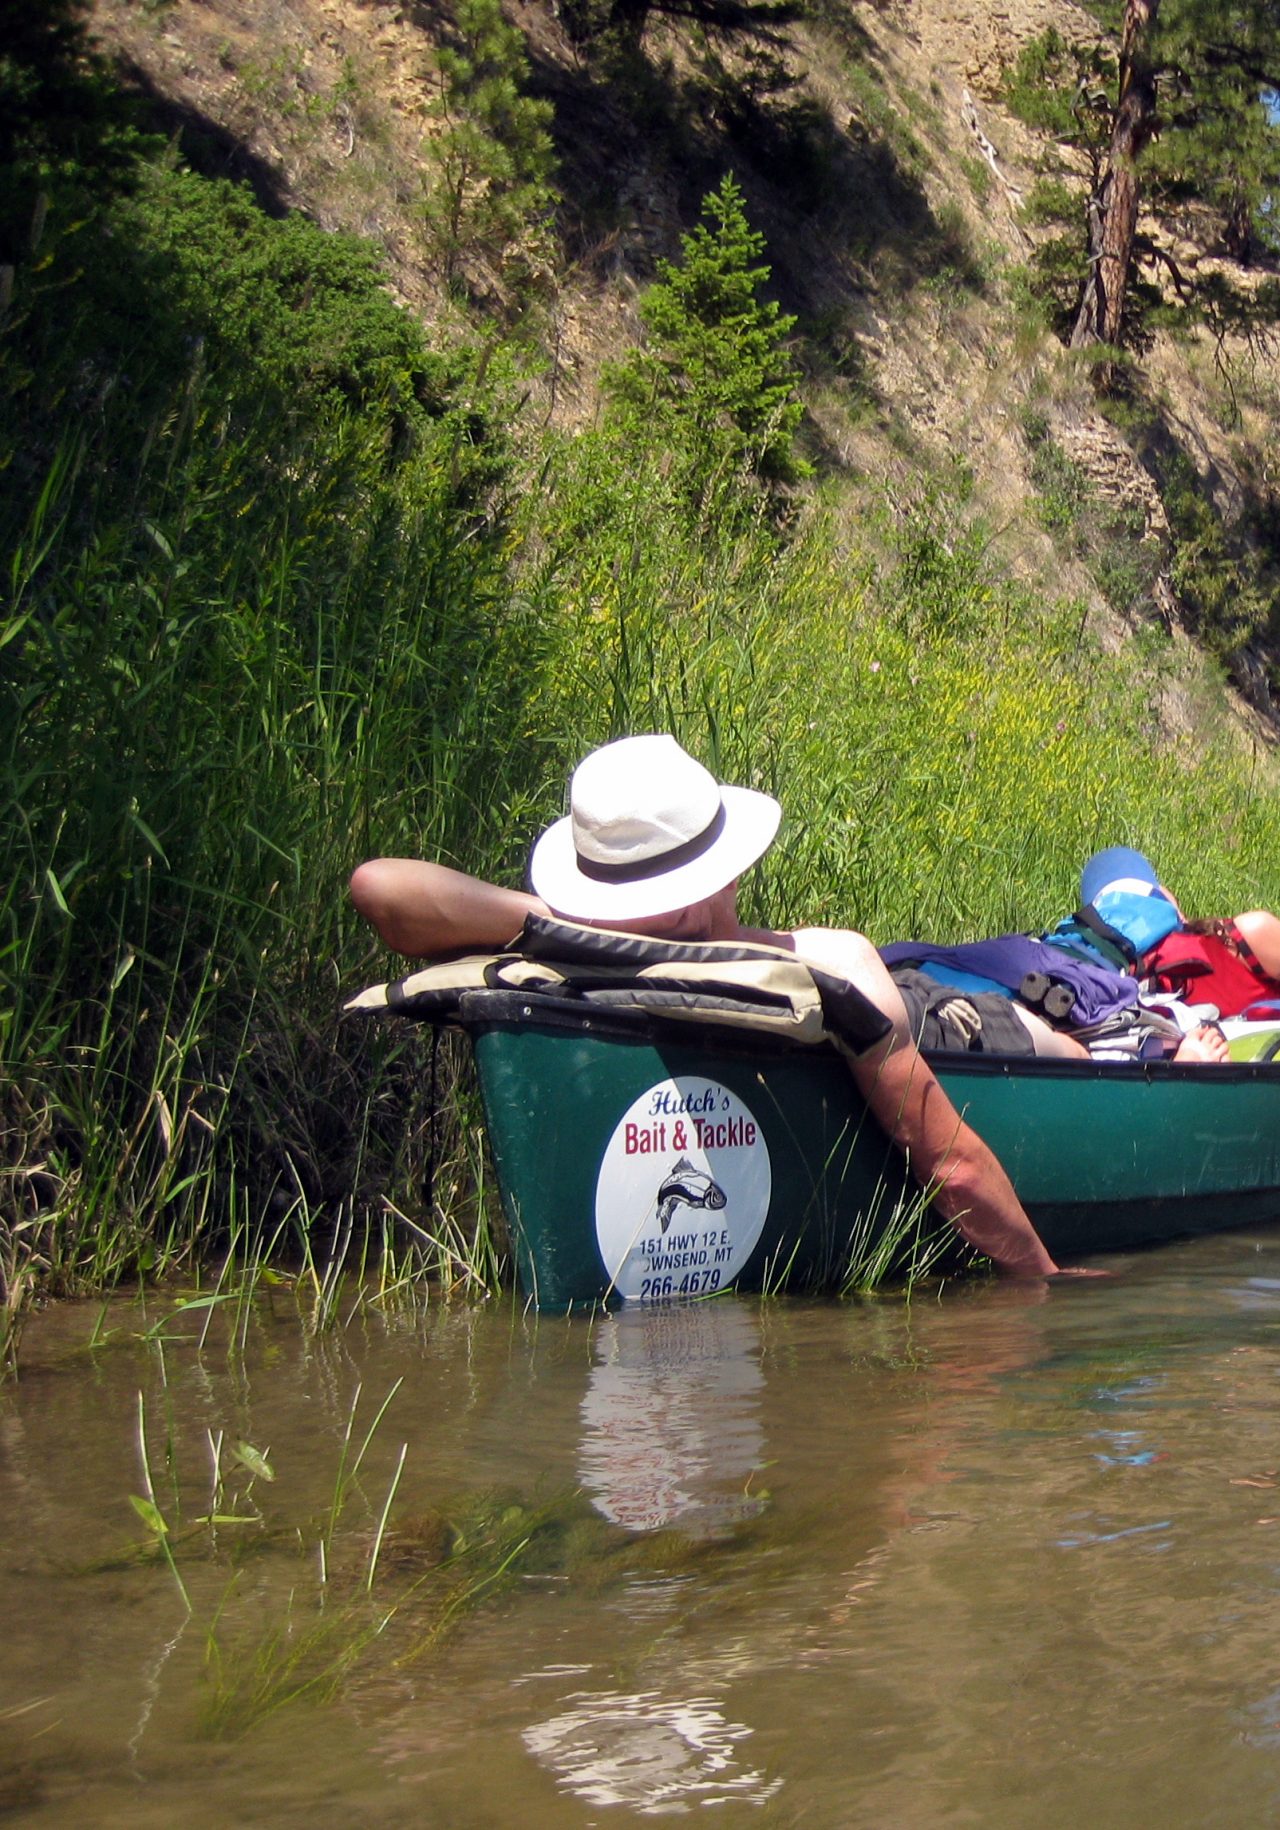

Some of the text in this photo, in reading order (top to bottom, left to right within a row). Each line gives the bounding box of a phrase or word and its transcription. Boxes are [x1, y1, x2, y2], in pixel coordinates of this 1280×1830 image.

[649, 1088, 730, 1115] Hutch's
[625, 1117, 756, 1154] Bait & Tackle
[640, 1230, 730, 1255] 151 HWY 12 E.
[715, 1247, 733, 1262] MT
[641, 1269, 721, 1298] 266-4679
